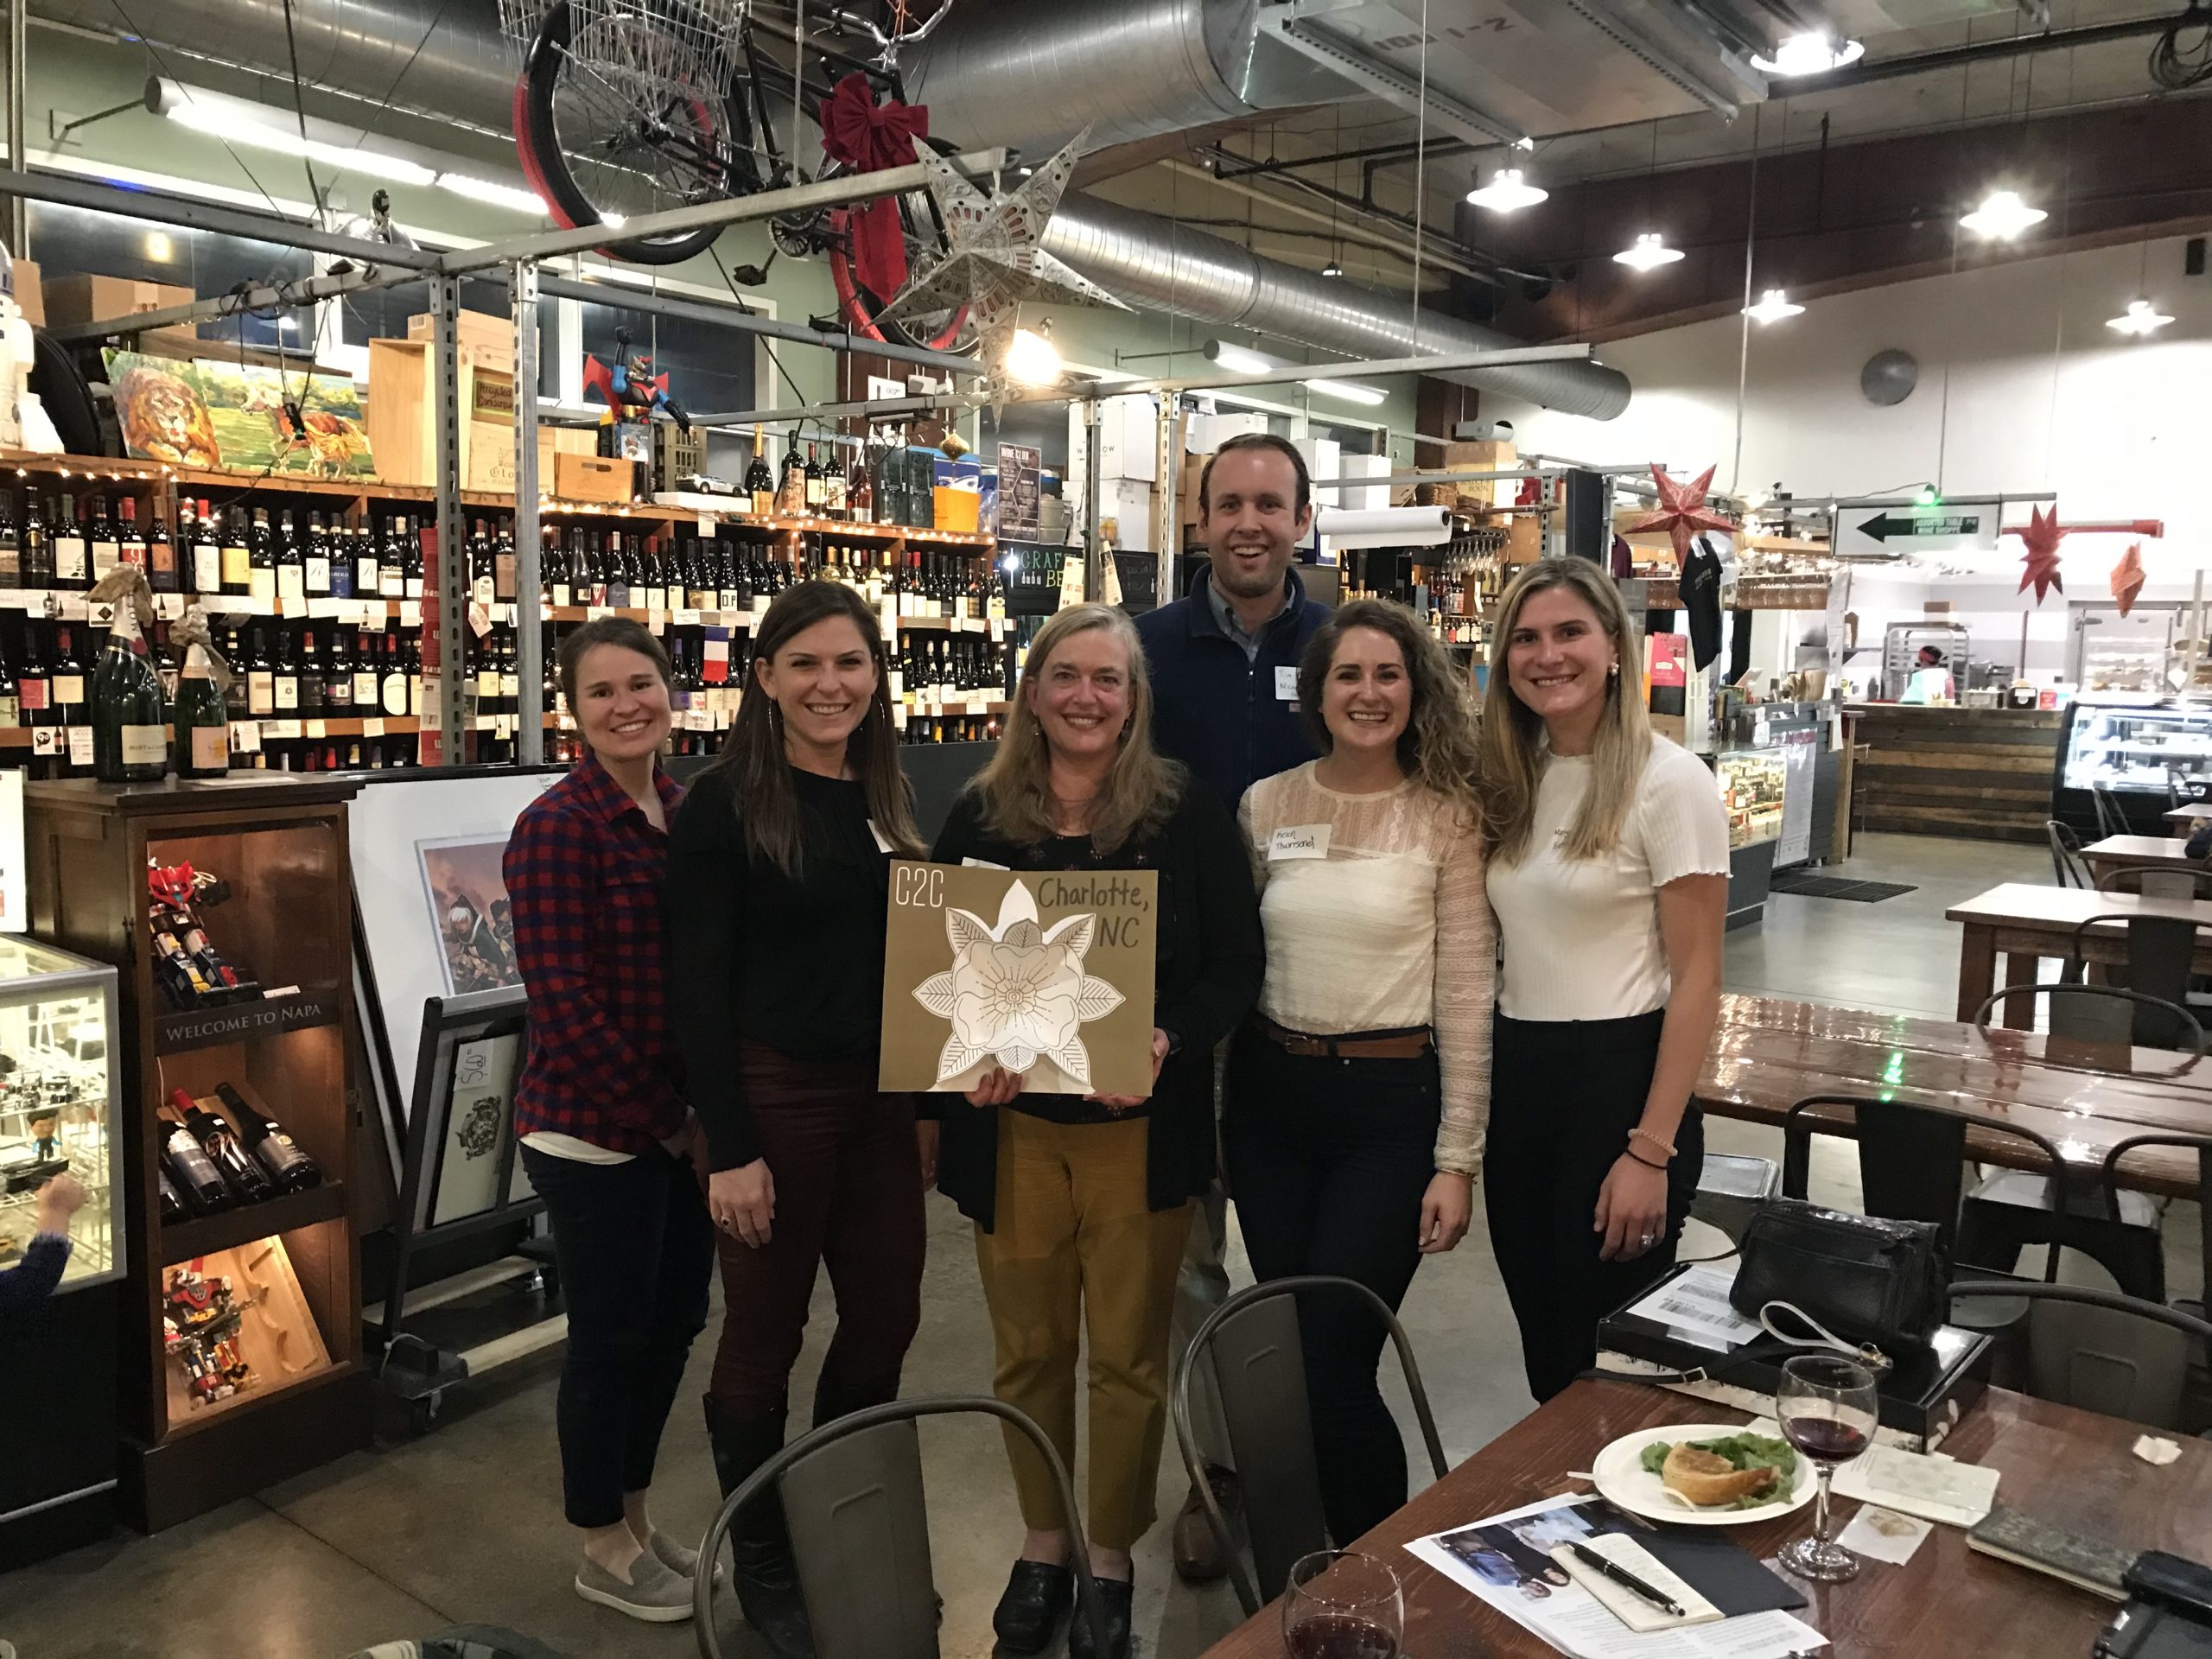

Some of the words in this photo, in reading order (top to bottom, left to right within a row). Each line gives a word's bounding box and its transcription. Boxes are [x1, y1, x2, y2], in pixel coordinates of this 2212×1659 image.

[895, 867, 944, 907] C2C
[1038, 876, 1148, 912] Charlotte,
[1098, 916, 1140, 948] NC
[166, 1016, 250, 1041] WELCOME
[254, 1012, 276, 1027] TO
[281, 1004, 321, 1021] NAPA
